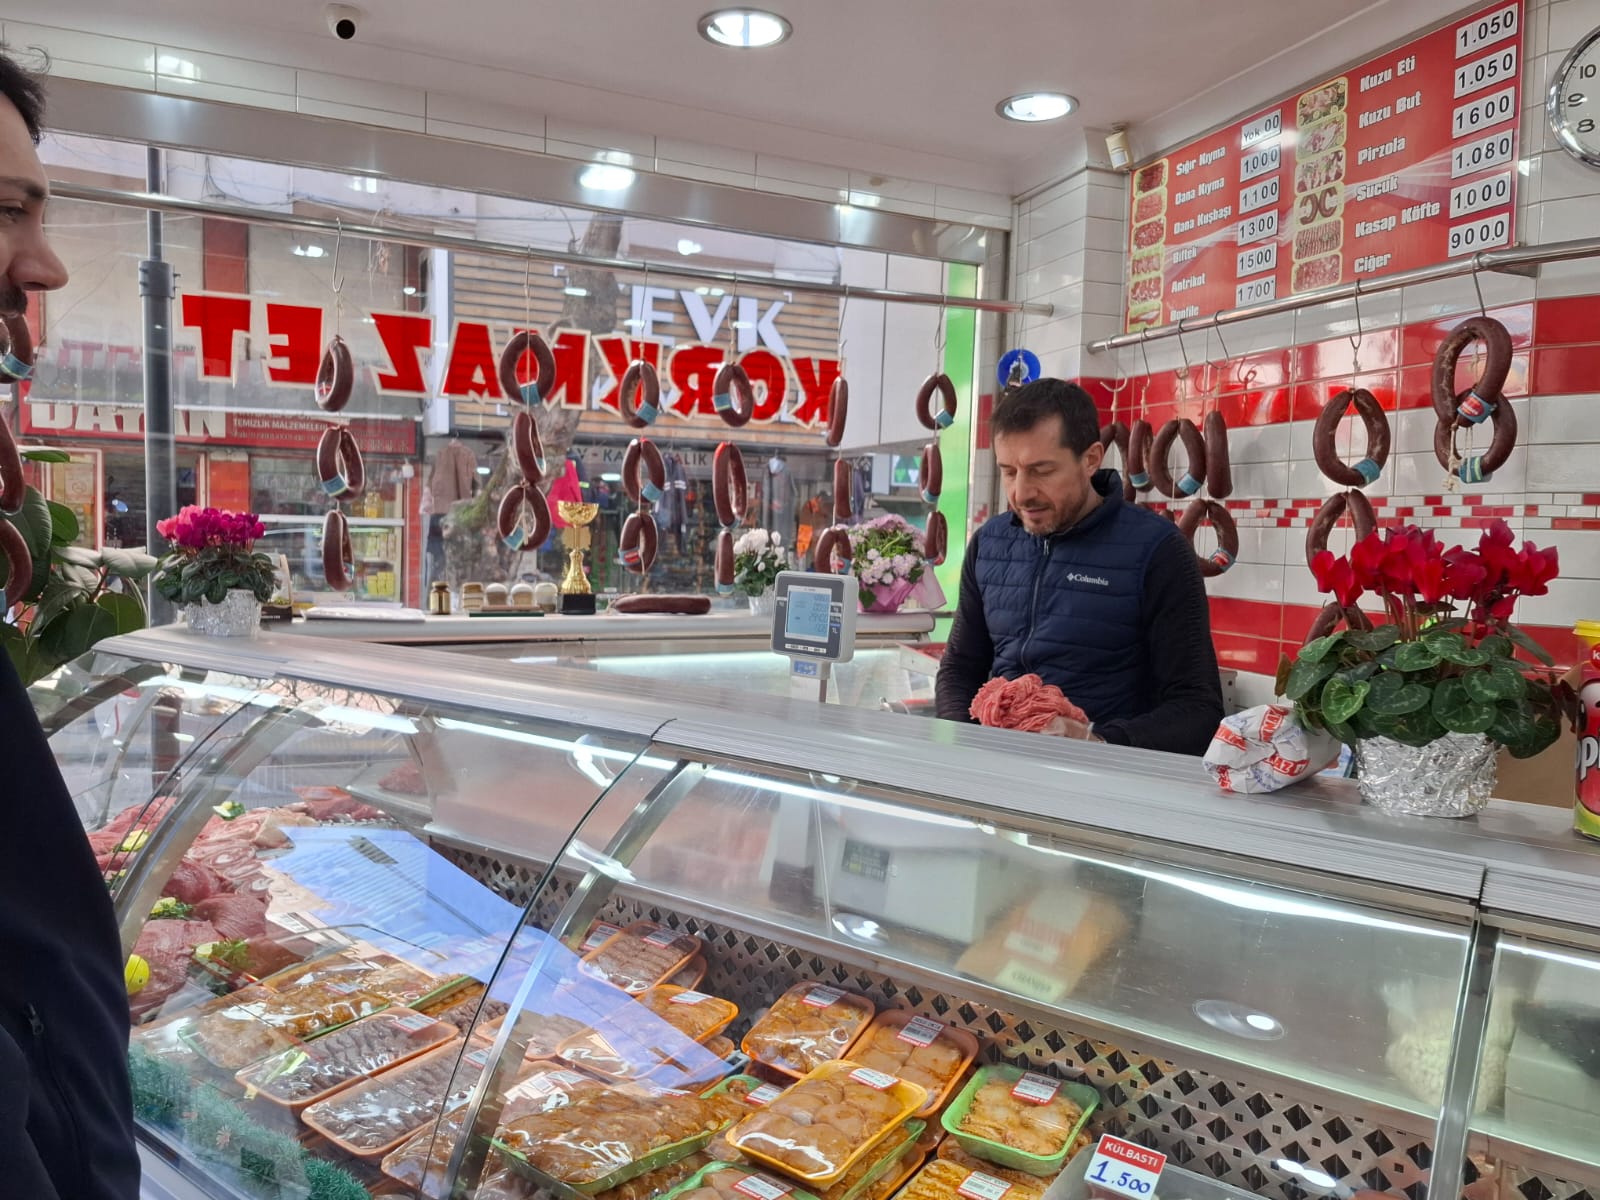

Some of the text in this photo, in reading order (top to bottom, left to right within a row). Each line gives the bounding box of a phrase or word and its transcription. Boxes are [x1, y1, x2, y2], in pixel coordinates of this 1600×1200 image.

[1461, 10, 1514, 47] 1.050
[1360, 55, 1416, 92] Kuzu Eti
[1458, 53, 1513, 88] 1.050
[1580, 64, 1597, 79] 10
[1359, 91, 1422, 129] Kuzu But
[1456, 95, 1510, 129] 1600
[1577, 119, 1595, 133] 8
[1357, 135, 1406, 165] Pirzola
[1455, 137, 1510, 169] 1.080
[1175, 189, 1196, 206] Dana
[1356, 175, 1400, 201] Sucuk
[1173, 218, 1195, 236] Dana
[1239, 215, 1274, 238] 1300
[1355, 201, 1441, 238] Kasap Köfte
[1239, 249, 1272, 270] 1500
[1354, 252, 1392, 273] Ciğer
[1074, 573, 1109, 586] Columbia
